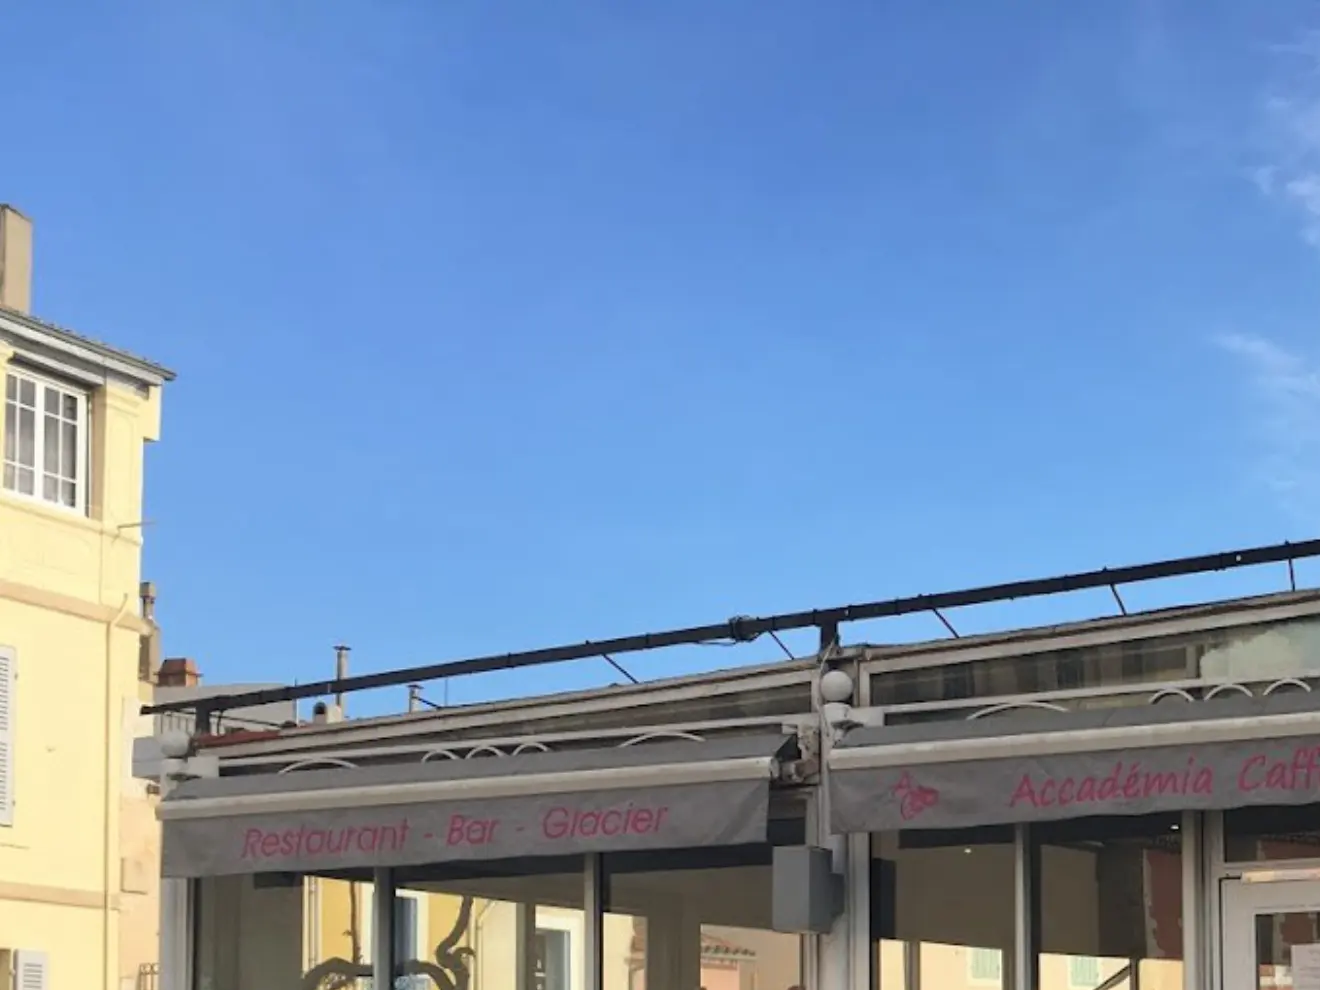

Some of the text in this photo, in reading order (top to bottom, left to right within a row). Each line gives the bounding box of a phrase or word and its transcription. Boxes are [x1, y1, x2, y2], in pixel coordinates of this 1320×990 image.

[1009, 754, 1214, 809] Accadémia
[242, 822, 411, 859] Restaurant
[446, 813, 501, 845] Bar
[542, 805, 670, 840] Glacier
